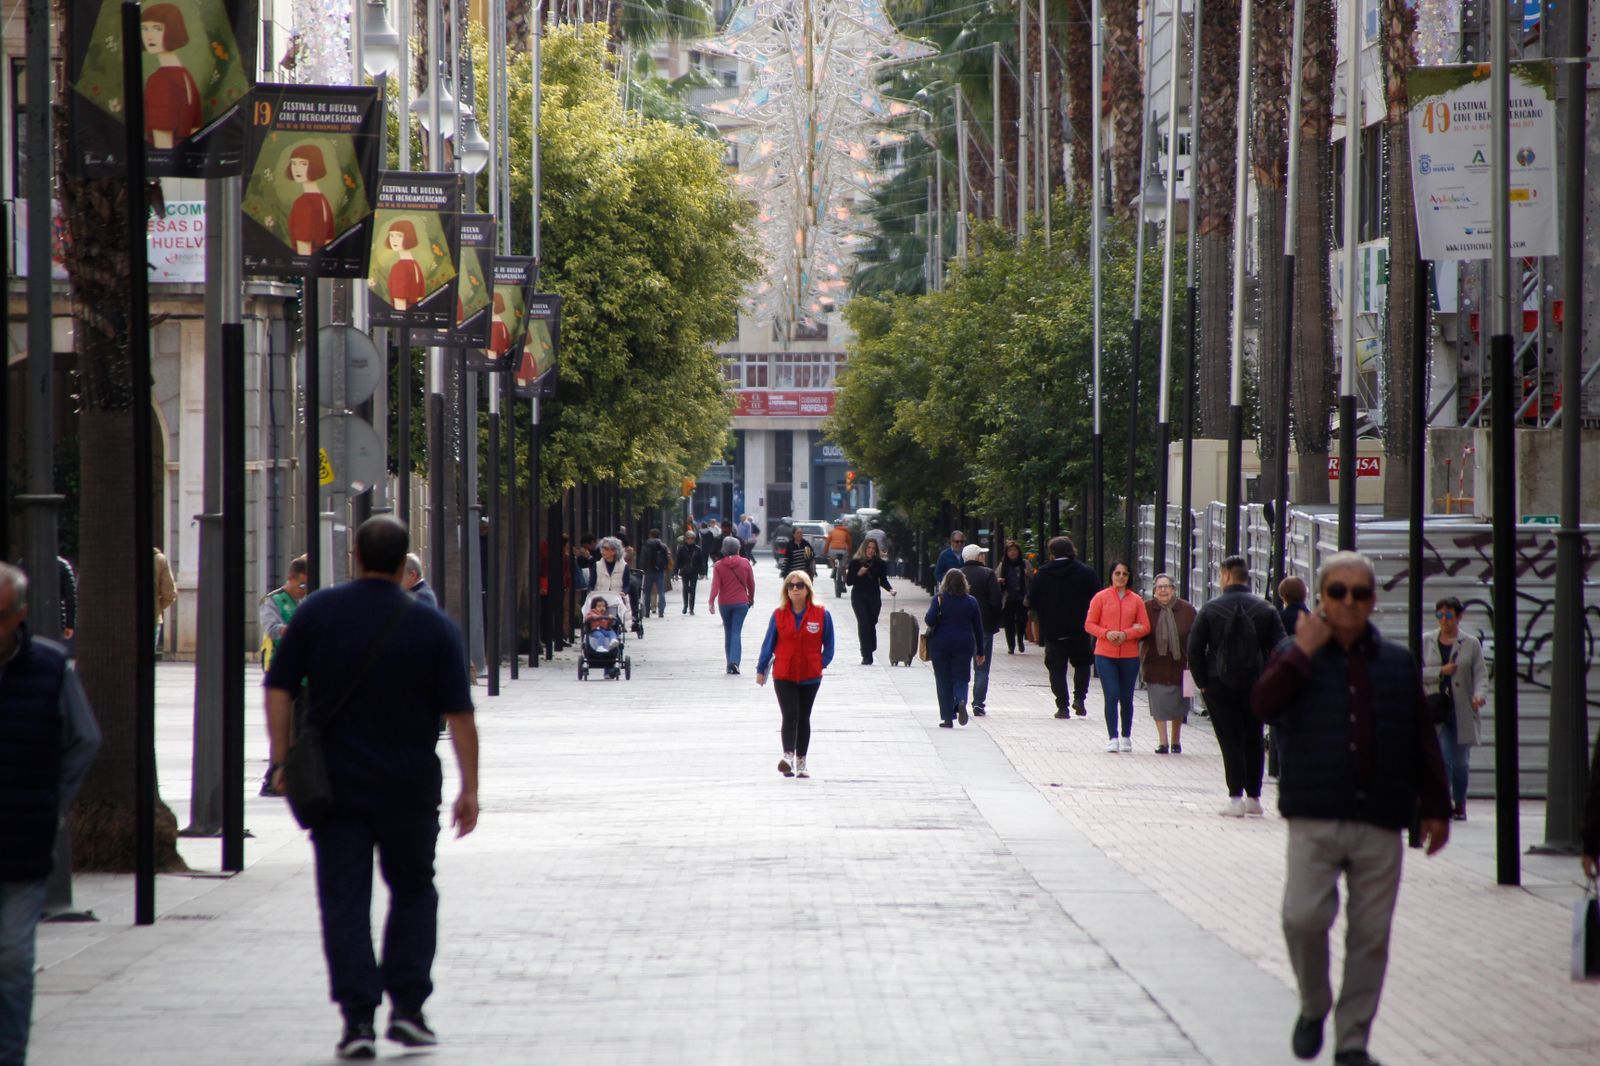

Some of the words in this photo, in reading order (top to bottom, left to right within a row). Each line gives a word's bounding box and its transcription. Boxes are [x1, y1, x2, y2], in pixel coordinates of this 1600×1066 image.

[283, 101, 315, 112] FESTIVAL
[318, 103, 327, 112] DE
[329, 104, 357, 113] HUELVA
[1453, 100, 1488, 111] FESTIVAL
[1507, 98, 1534, 108] UELVA
[279, 112, 296, 121] CINE
[299, 112, 362, 123] IBEROAMERICANO
[1422, 101, 1450, 134] 49
[1453, 112, 1471, 122] CINE
[152, 237, 204, 249] HUELV
